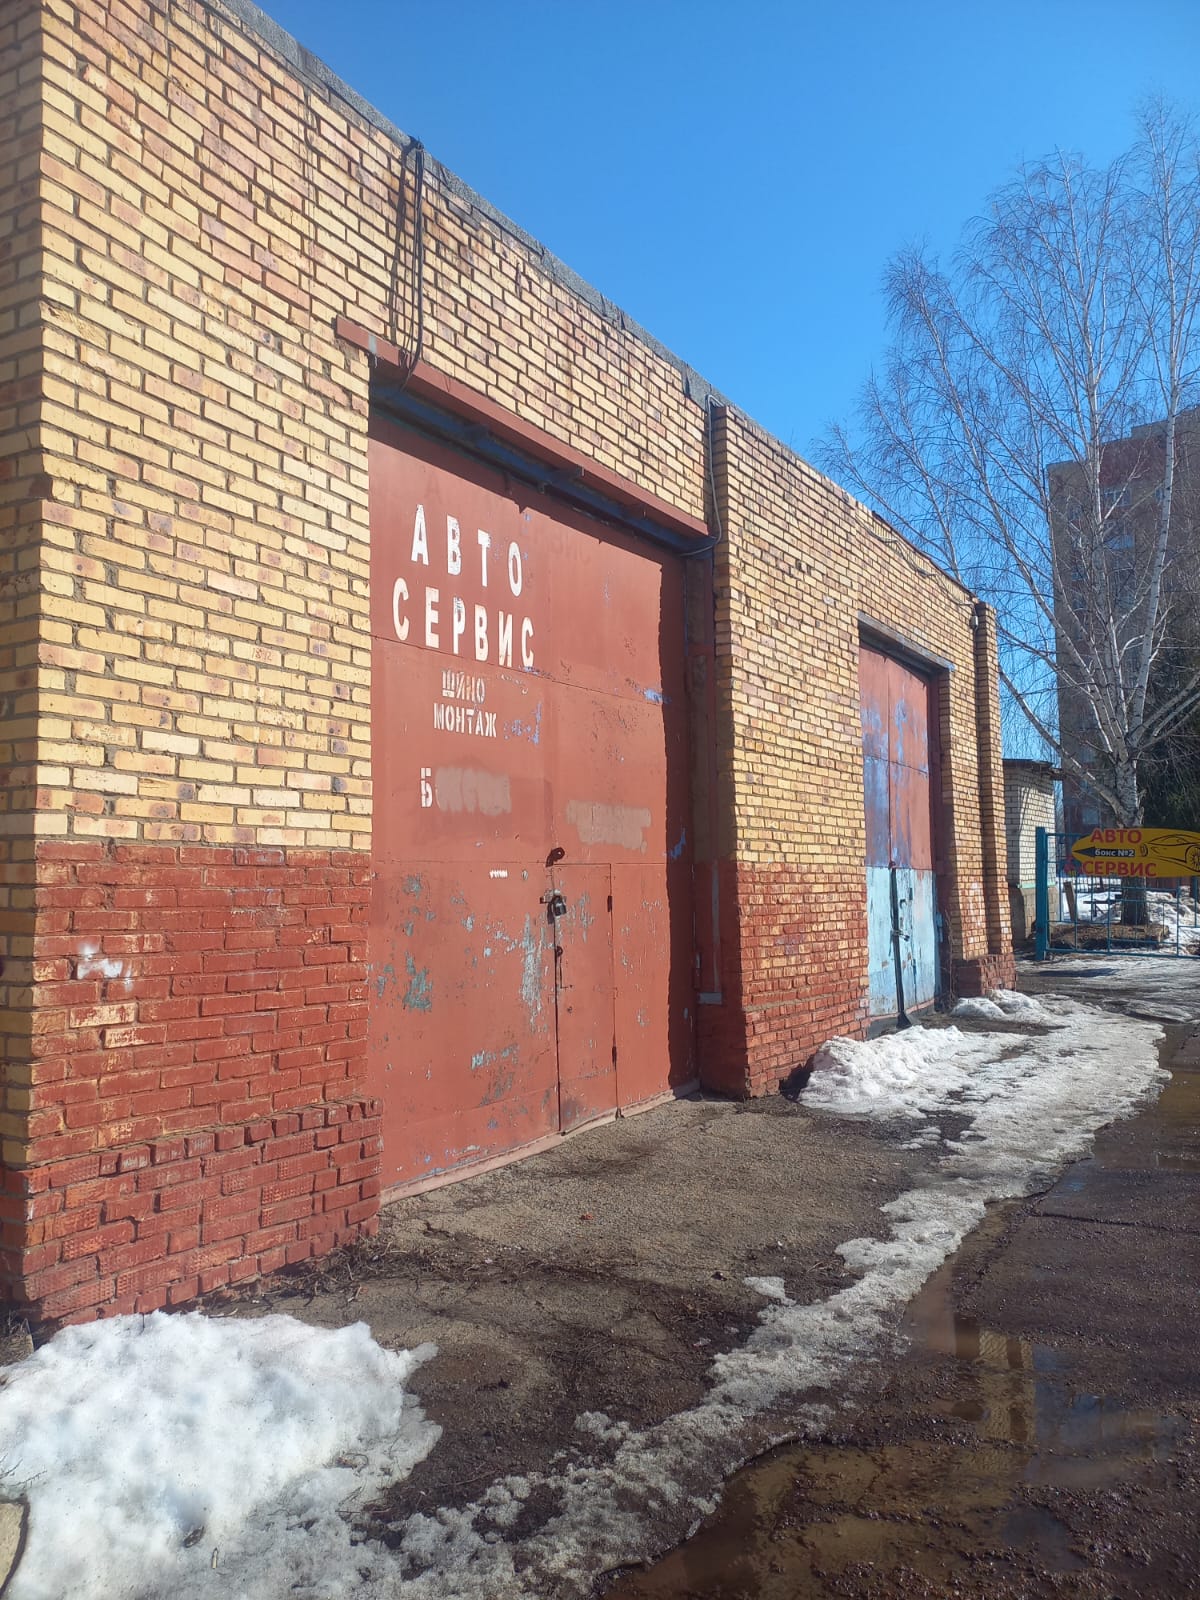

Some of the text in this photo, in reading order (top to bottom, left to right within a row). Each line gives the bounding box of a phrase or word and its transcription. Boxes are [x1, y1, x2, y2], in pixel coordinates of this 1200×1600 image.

[411, 504, 523, 597] АВТО
[392, 577, 535, 669] СЕРВИС
[433, 702, 497, 738] МОНТАЖ
[1090, 828, 1142, 844] АВТО
[1082, 861, 1157, 877] СЕРВИС
